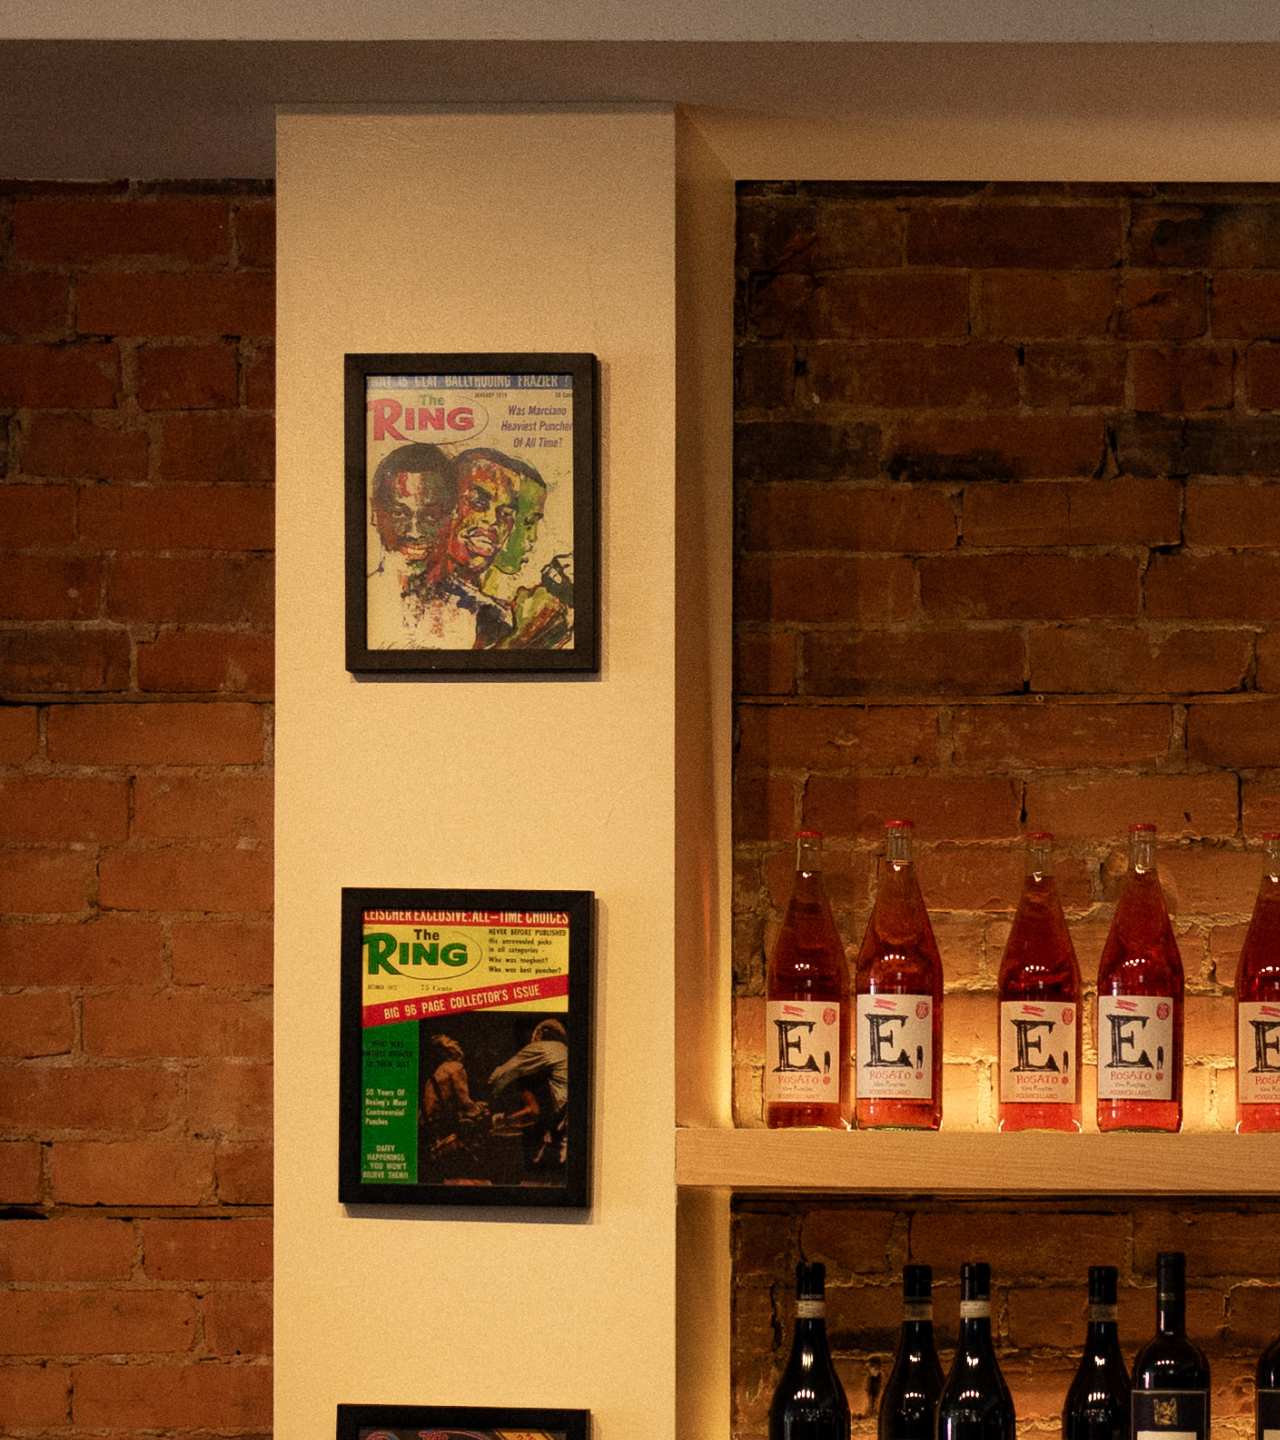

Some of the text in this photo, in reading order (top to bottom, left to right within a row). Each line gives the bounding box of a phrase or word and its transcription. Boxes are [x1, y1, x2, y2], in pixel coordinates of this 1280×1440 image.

[518, 376, 559, 388] FRAZIER
[420, 394, 444, 406] The
[508, 405, 567, 416] Was Marciano
[367, 398, 475, 441] RING
[501, 421, 537, 432] Heaviest
[513, 437, 523, 448] Of
[525, 437, 537, 448] All
[414, 929, 440, 941] The
[362, 932, 468, 976] RING
[384, 984, 541, 1019] BIG 96 PAGE COLLECTOR'S ISSUE
[777, 1075, 820, 1085] ROSATO
[870, 1071, 911, 1080] ROSATO
[1016, 1075, 1058, 1085] ROSATO
[1111, 1071, 1152, 1081] ROSATO
